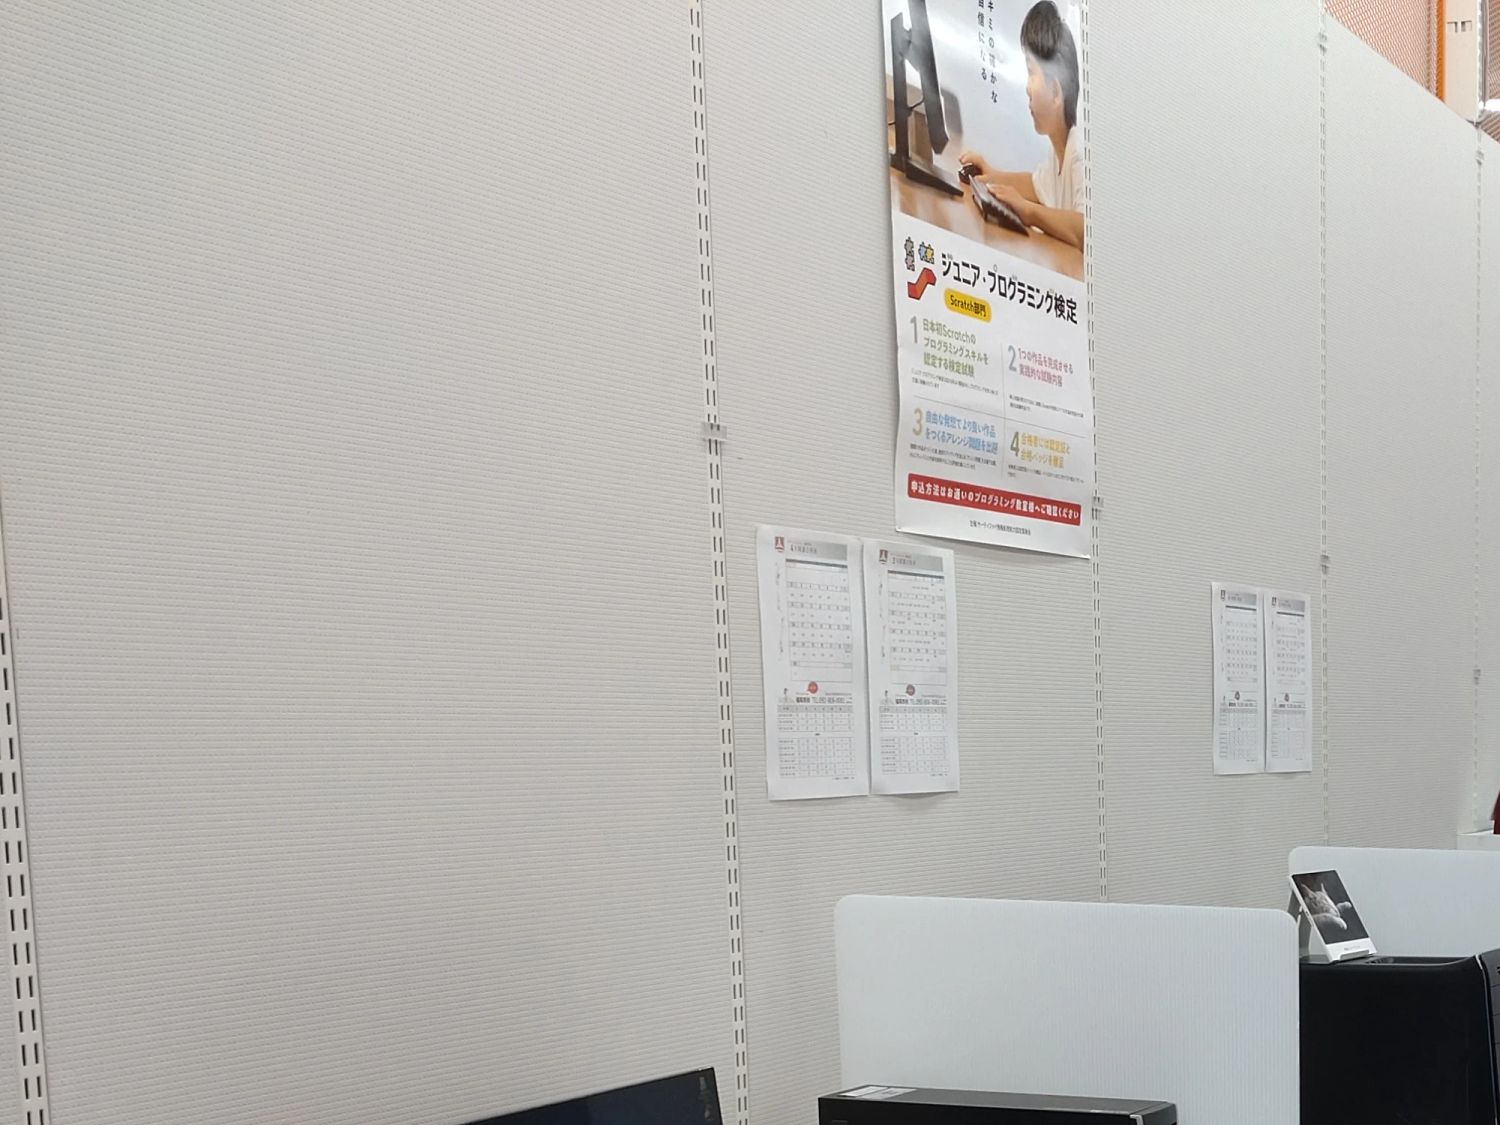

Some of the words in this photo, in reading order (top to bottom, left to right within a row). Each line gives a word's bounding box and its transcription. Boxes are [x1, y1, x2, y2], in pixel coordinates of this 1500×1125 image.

[941, 252, 1078, 325] ジュニア・プログラミング検定
[950, 294, 986, 317] Scratch部門
[909, 315, 918, 344] 1
[1008, 345, 1017, 372] 2
[912, 407, 923, 436] 3
[1010, 431, 1020, 457] 4
